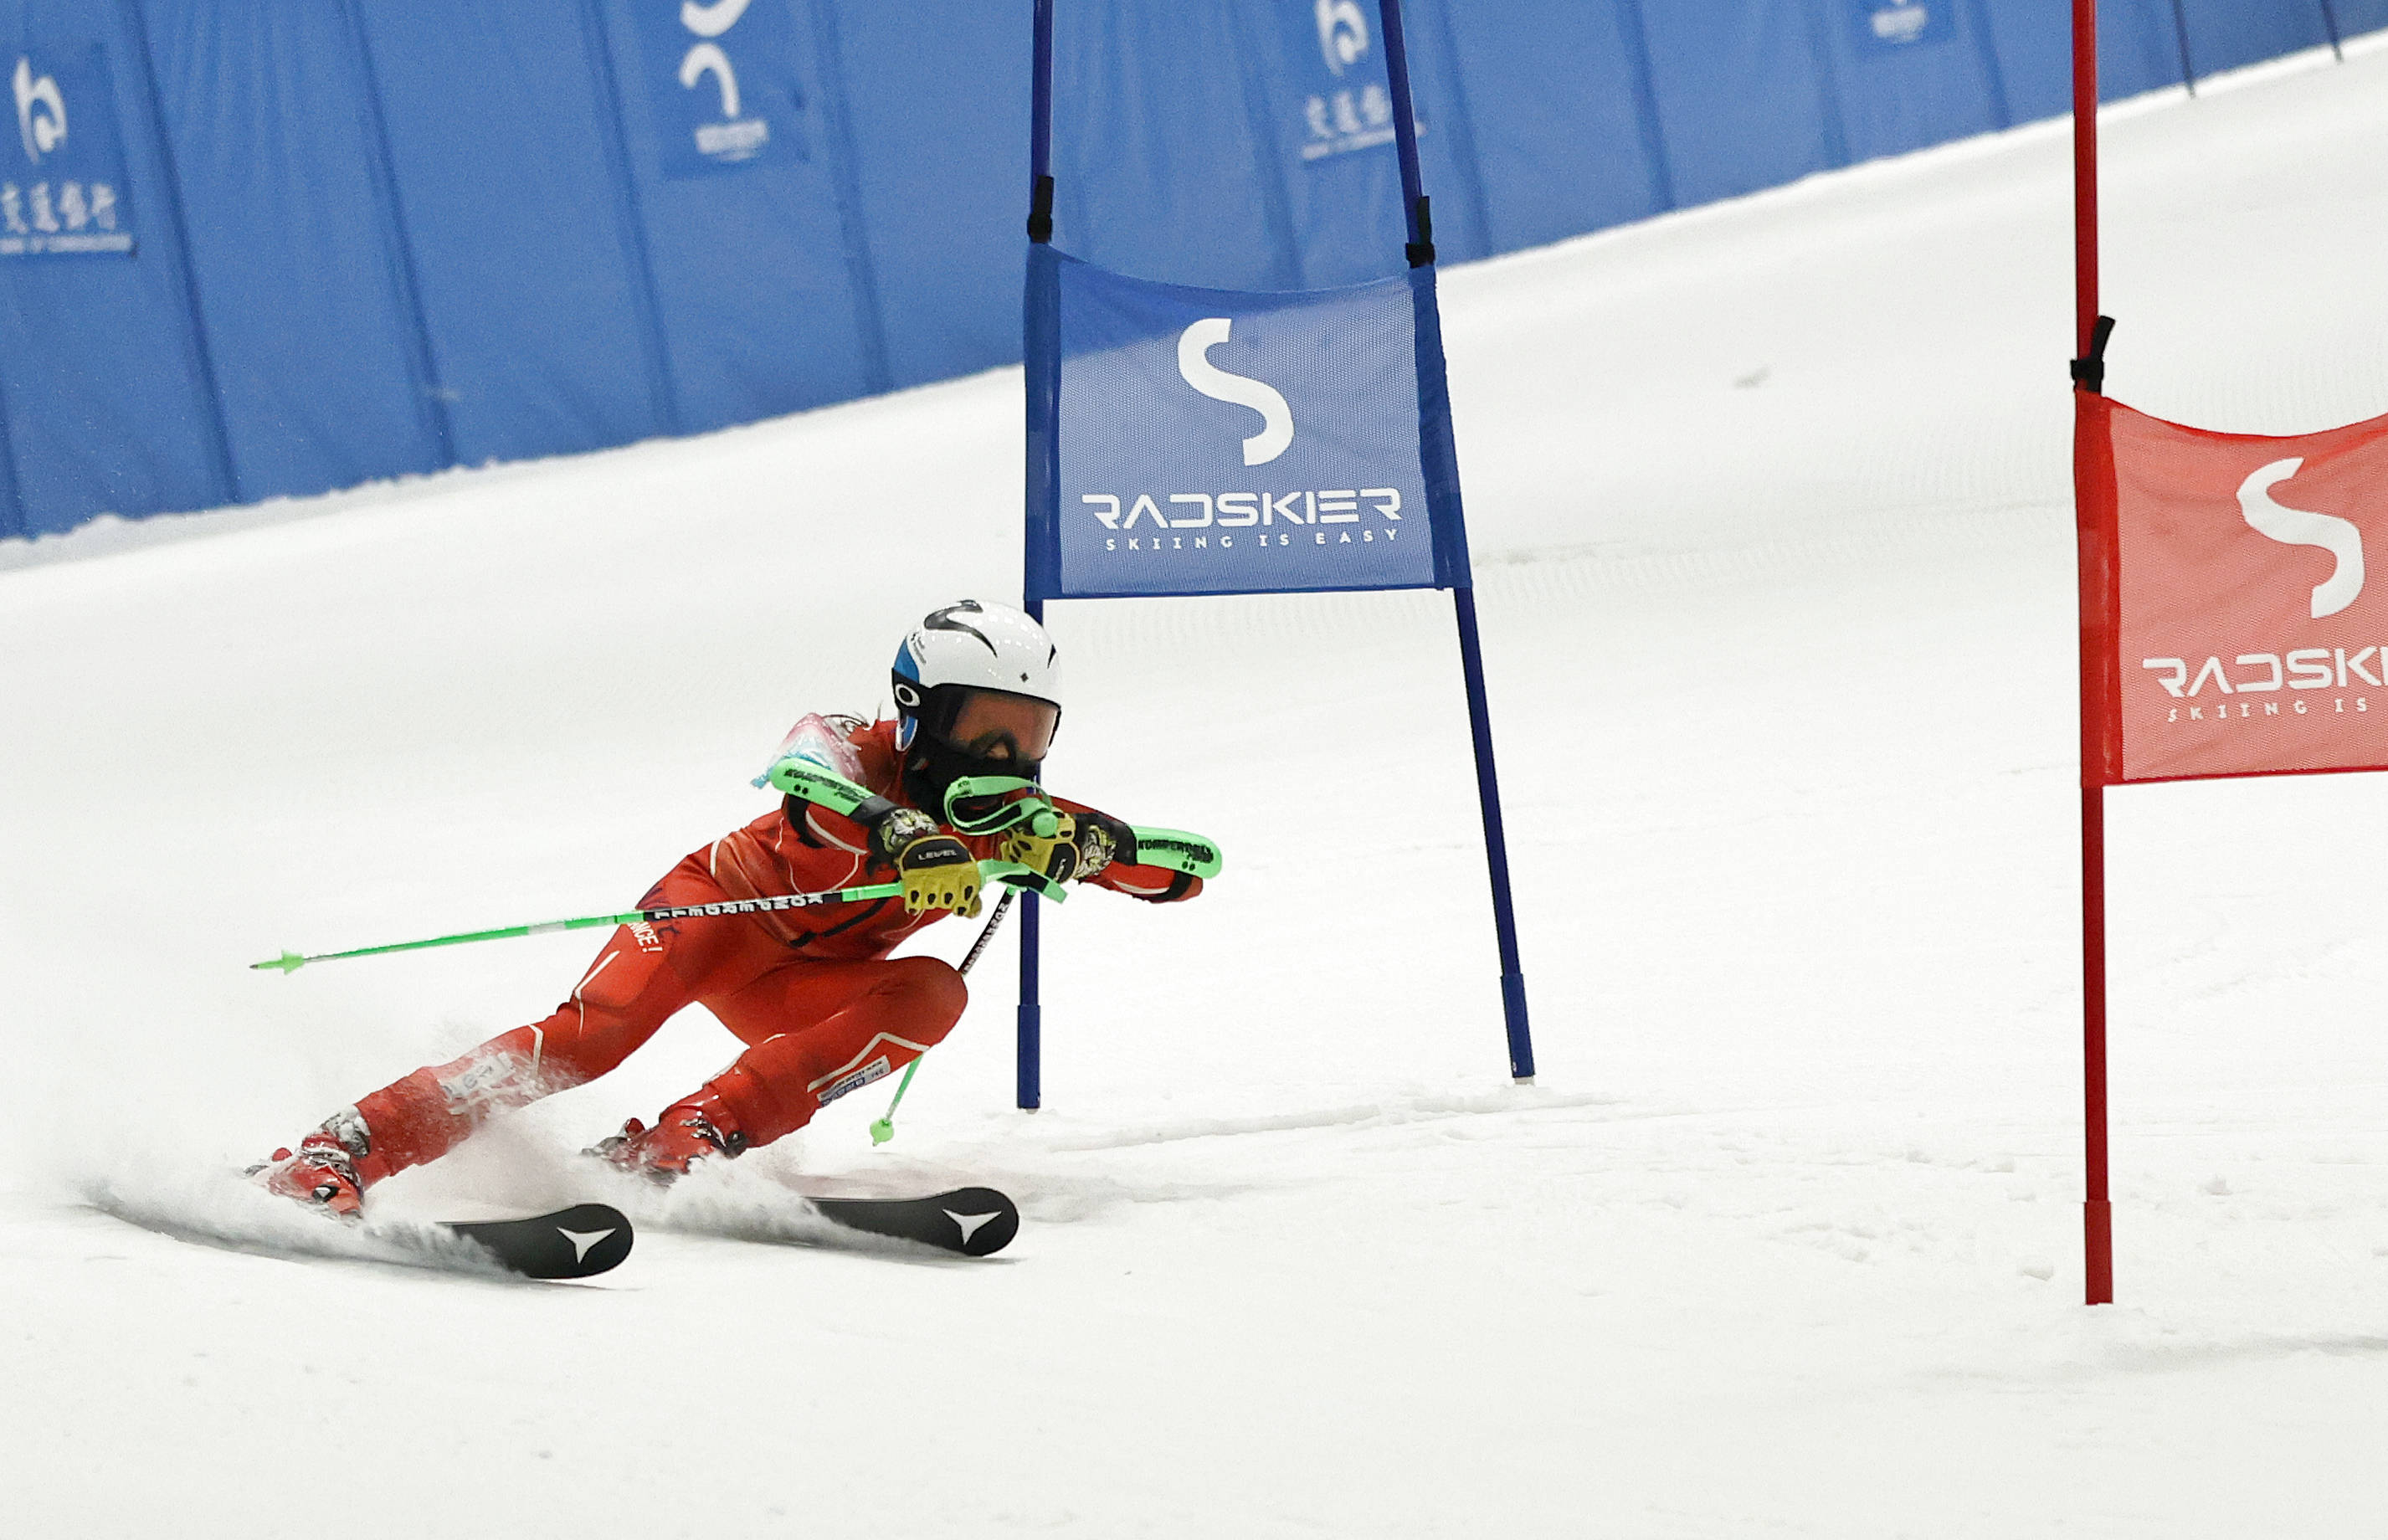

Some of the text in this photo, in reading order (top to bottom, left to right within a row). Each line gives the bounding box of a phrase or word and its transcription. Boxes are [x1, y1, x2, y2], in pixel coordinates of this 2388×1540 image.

[1081, 488, 1403, 530] RADSKIER
[1106, 528, 1399, 552] SKIING IS EASY
[2167, 696, 2368, 723] SKIING IS
[917, 849, 957, 861] LEVEL
